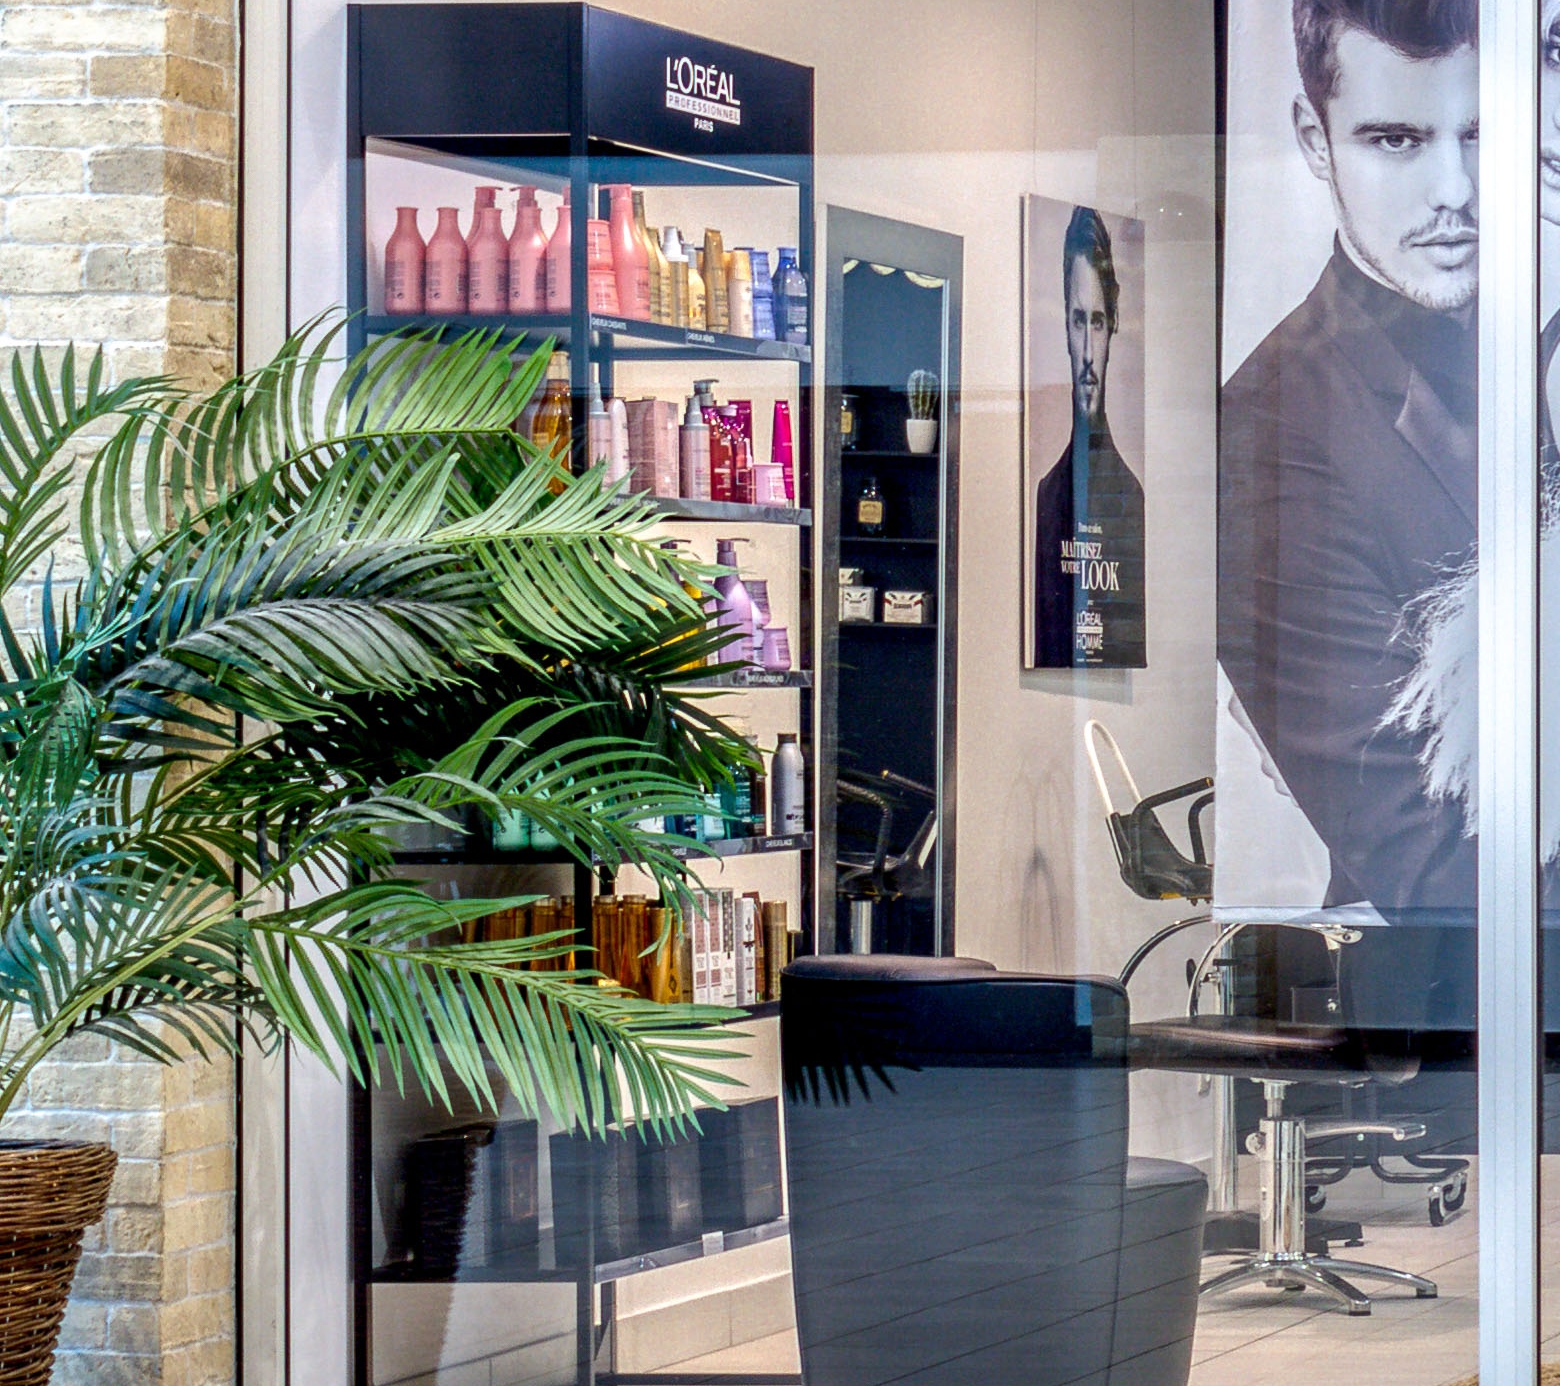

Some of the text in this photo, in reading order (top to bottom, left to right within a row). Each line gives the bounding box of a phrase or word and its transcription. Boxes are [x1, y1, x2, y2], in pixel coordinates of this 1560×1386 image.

[666, 56, 741, 106] L'ORÉAL
[668, 94, 740, 122] PROFESSIONNEL
[694, 117, 714, 133] PARIS
[1080, 559, 1120, 591] LOOK
[1075, 633, 1104, 650] HOMME
